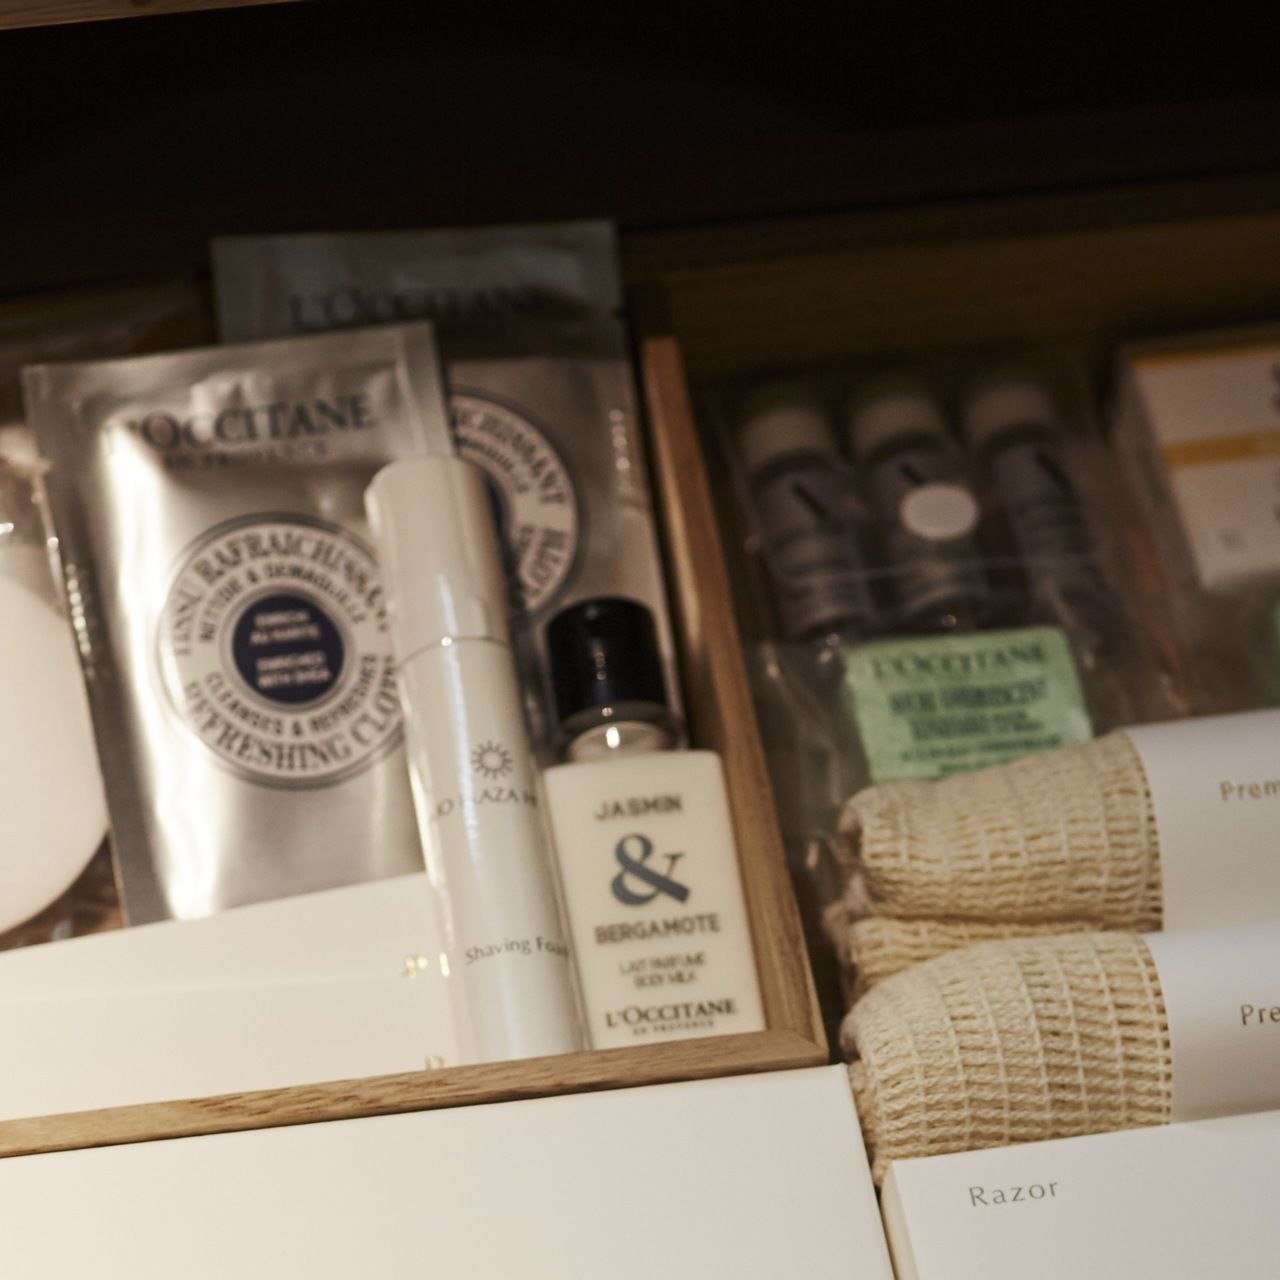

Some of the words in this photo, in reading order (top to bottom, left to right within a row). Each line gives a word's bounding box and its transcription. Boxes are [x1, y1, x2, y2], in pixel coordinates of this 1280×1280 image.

[594, 794, 683, 821] JASMIN
[611, 833, 691, 906] &
[594, 913, 721, 945] BERGAMOTE
[465, 938, 532, 965] Shaving
[605, 998, 738, 1029] L'OCCITANE
[968, 1181, 1059, 1208] Razor
